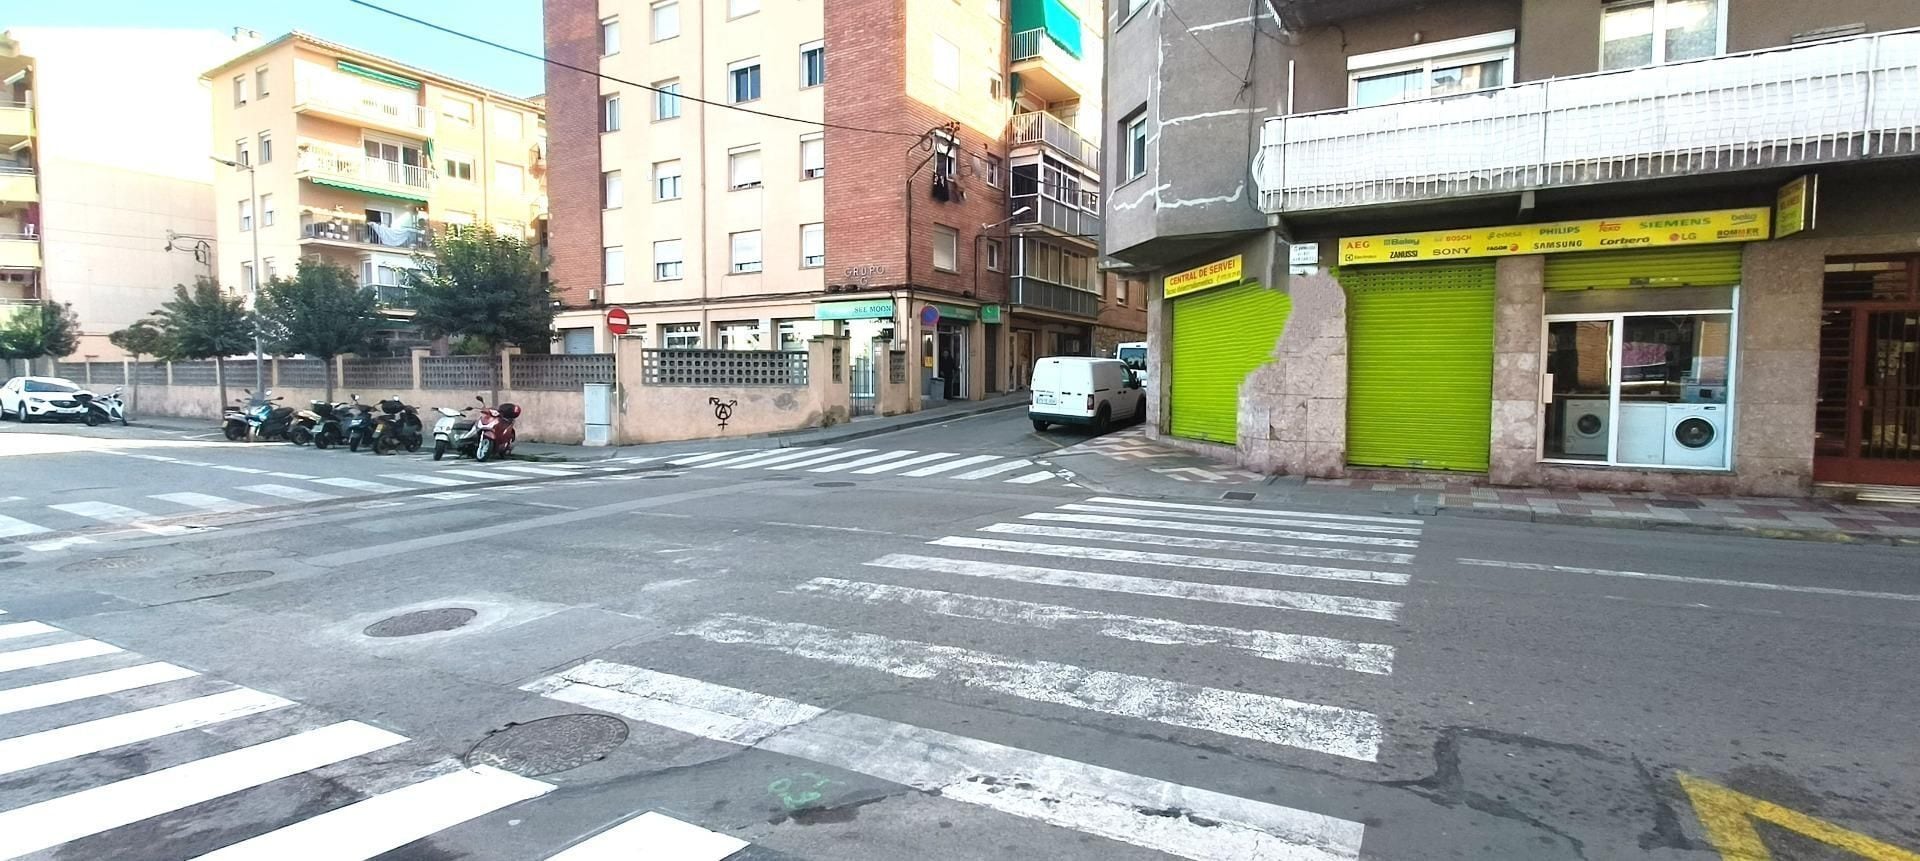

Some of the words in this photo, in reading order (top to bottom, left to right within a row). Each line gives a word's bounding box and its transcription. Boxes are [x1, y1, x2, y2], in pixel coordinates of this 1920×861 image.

[1346, 240, 1370, 249] AEG
[1446, 234, 1472, 242] BOSCH
[1539, 226, 1581, 235] PHILIPS
[1639, 217, 1712, 229] SIEMENS
[1390, 250, 1418, 258] ZANUSSI
[1432, 247, 1471, 256] SONY
[1533, 239, 1583, 250] SAMSUNG
[1681, 232, 1697, 241] LG
[845, 265, 884, 277] GRUPO
[1169, 272, 1198, 286] CENTRAL
[1198, 267, 1208, 278] DE
[1209, 259, 1236, 274] SERVEI
[869, 305, 892, 313] MOON
